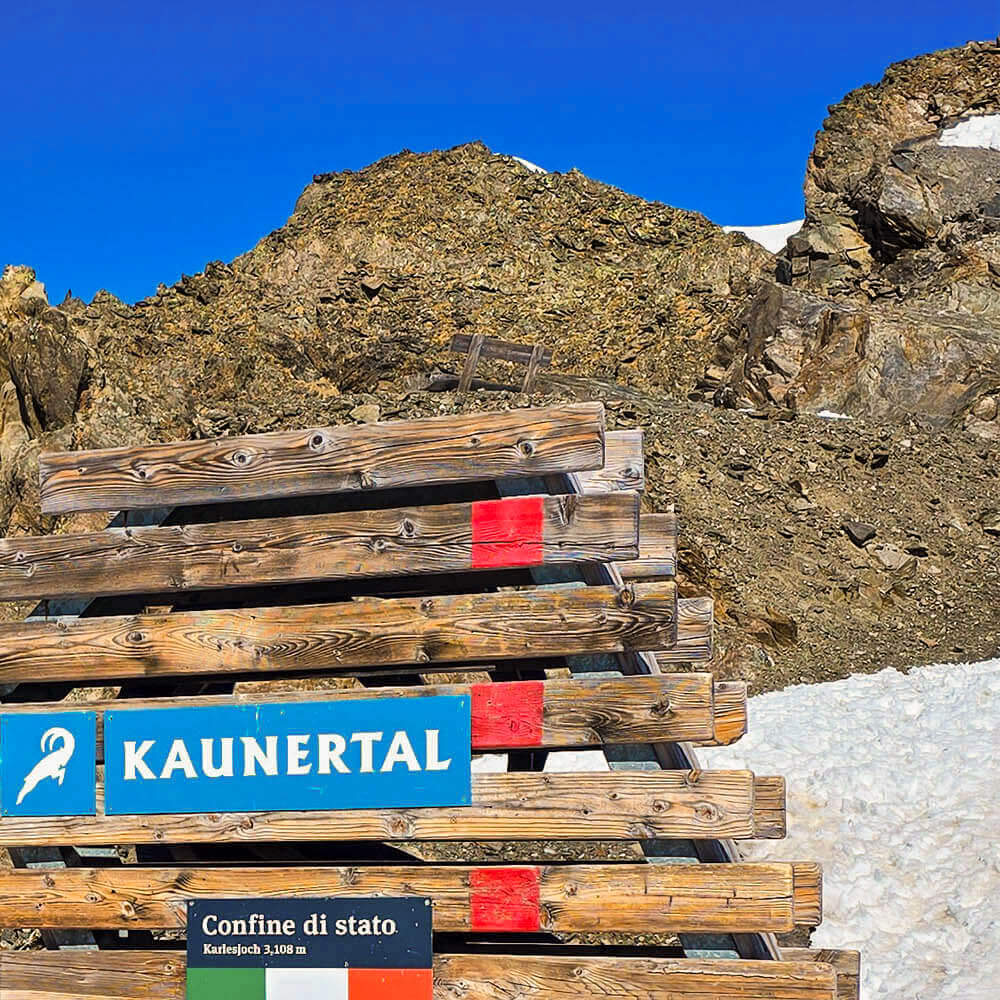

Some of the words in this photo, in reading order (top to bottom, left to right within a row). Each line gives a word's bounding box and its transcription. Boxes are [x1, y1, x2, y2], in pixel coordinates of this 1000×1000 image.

[123, 729, 452, 780] KAUNERTAL
[201, 913, 296, 936] Confine
[303, 913, 328, 936] di
[335, 915, 396, 936] stato
[203, 943, 261, 957] Karlesjoch
[263, 944, 294, 956] 3,108
[295, 945, 307, 955] m
